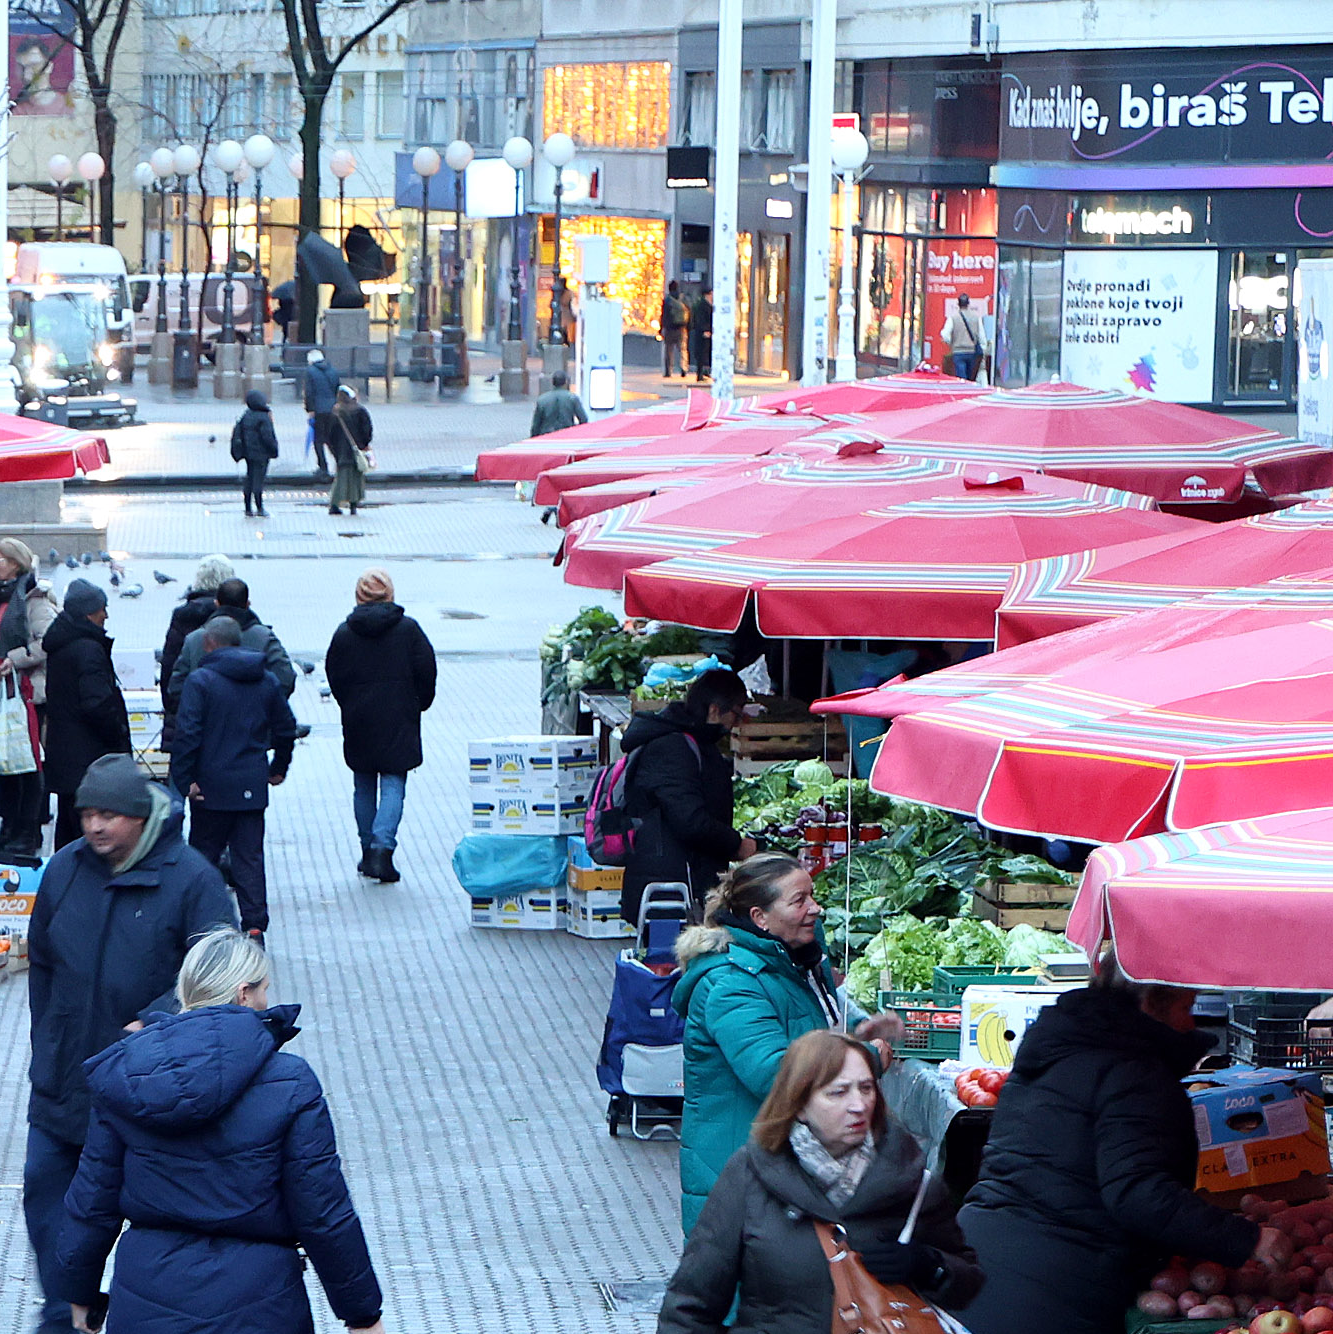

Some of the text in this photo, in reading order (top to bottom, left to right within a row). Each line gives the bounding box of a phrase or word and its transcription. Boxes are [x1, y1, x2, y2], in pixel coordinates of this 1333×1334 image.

[1009, 85, 1031, 128] Kad
[1057, 84, 1110, 142] bolje,
[1119, 81, 1248, 128] biraš
[1081, 206, 1193, 235] telemach
[951, 251, 995, 270] here
[1109, 296, 1140, 312] koje
[1145, 296, 1184, 313] tvoji
[1102, 316, 1162, 331] zapravo
[1083, 329, 1120, 344] dobiti
[496, 753, 525, 770] BONITA
[499, 798, 527, 815] BONITA
[1224, 1096, 1255, 1110] toco
[1203, 1151, 1297, 1175] CLA EXTRA
